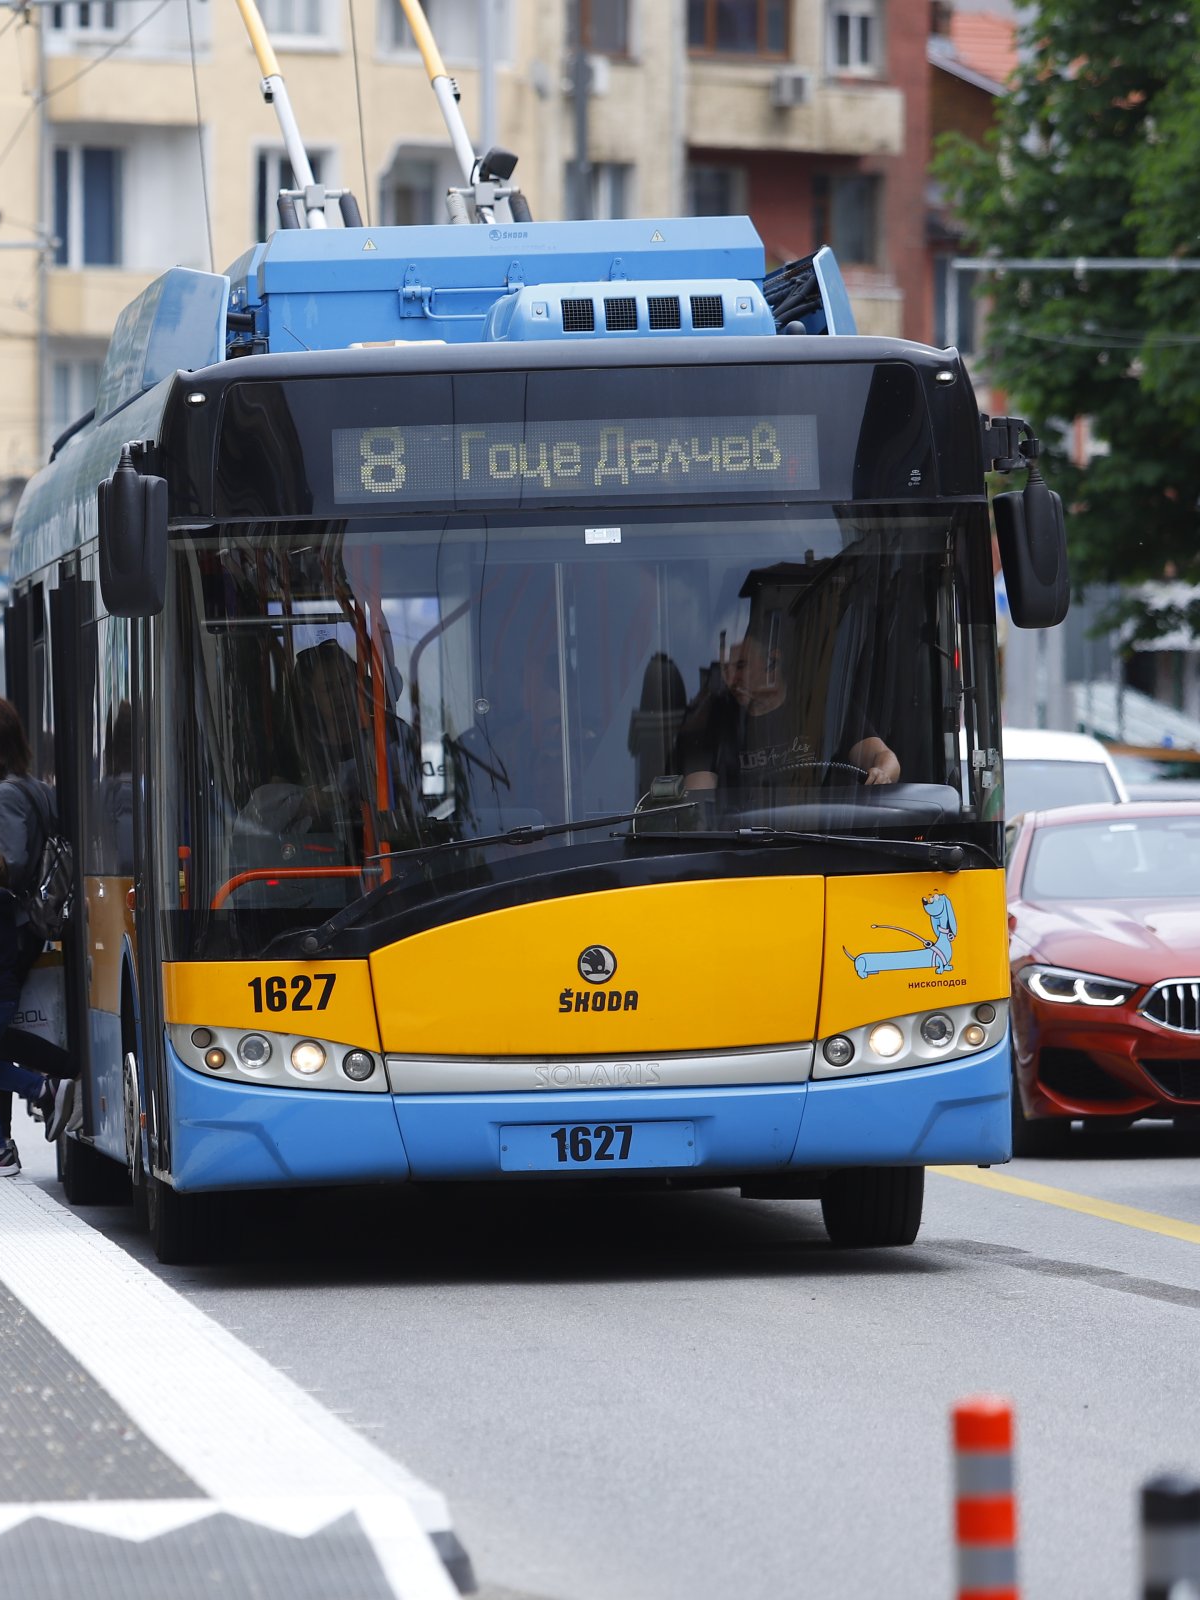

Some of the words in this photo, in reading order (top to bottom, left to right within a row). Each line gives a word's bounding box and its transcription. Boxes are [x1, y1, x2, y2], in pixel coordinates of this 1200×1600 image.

[359, 427, 406, 493] 8
[461, 431, 581, 488] Гоце
[594, 422, 782, 486] Делчев
[247, 973, 337, 1013] 1627
[558, 988, 639, 1013] ŠKODA
[534, 1062, 662, 1088] SOLARIS
[551, 1125, 633, 1162] 1627
